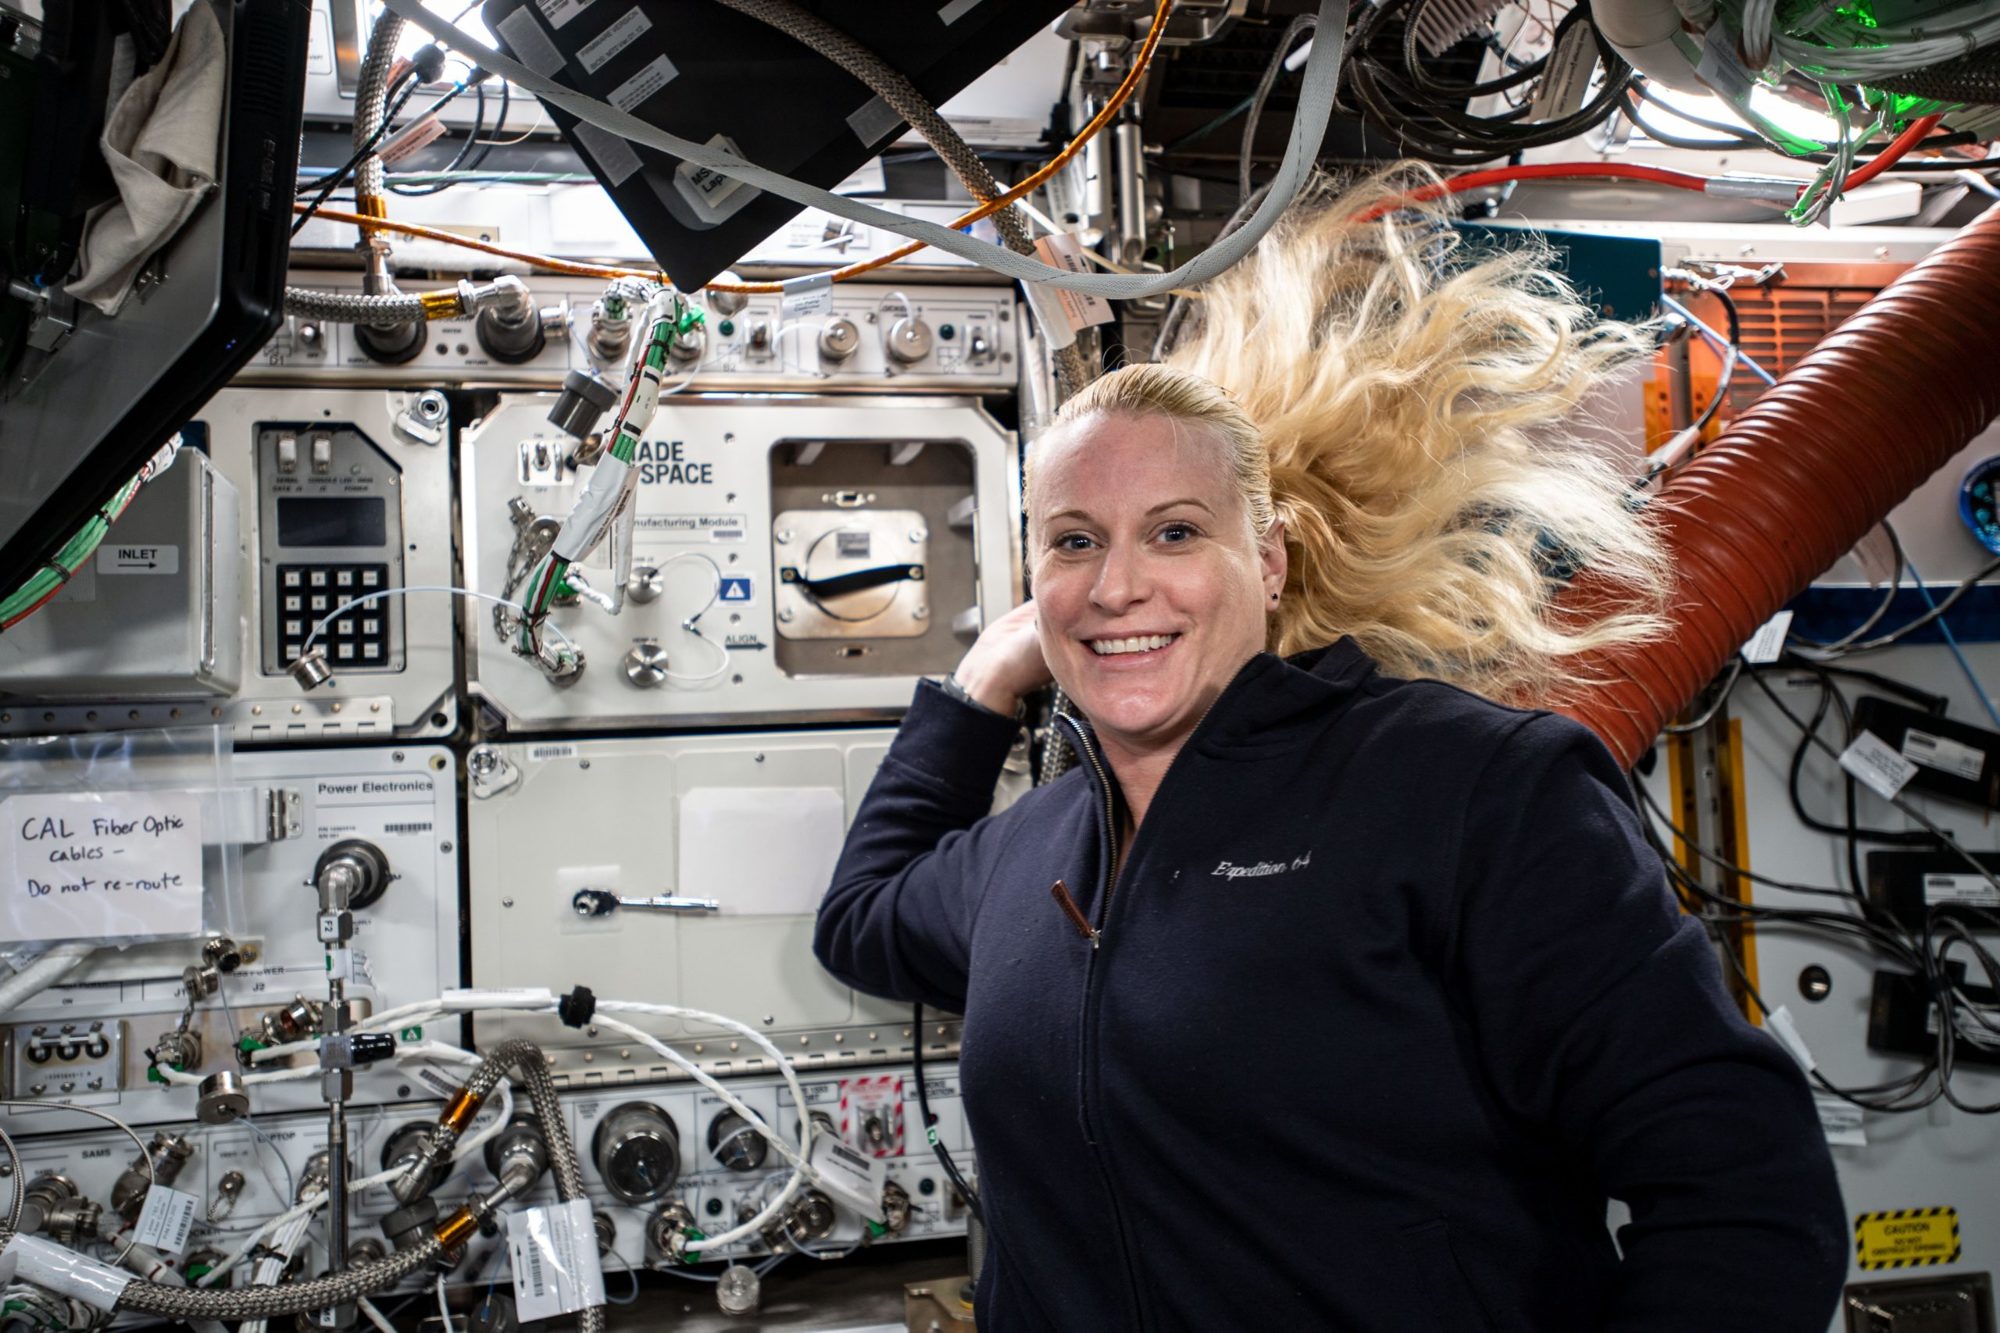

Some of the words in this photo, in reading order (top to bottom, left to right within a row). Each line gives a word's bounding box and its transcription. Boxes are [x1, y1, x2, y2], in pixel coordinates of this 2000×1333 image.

[612, 9, 639, 33] VERSION
[631, 441, 685, 462] ADE
[640, 463, 713, 485] SPACE
[633, 518, 696, 529] nufacturing
[699, 517, 738, 527] Module
[118, 548, 158, 560] INLET
[725, 634, 757, 644] ALIGN
[318, 783, 359, 795] Power
[362, 781, 434, 793] Electronics
[21, 817, 75, 842] CAL
[92, 817, 139, 838] Fiber
[143, 814, 185, 838] Optic
[49, 845, 104, 864] cables
[1210, 859, 1288, 883] Expedition
[28, 879, 52, 898] Do
[60, 876, 97, 894] not
[104, 871, 183, 892] re-route
[325, 919, 333, 932] F2
[252, 983, 266, 992] J2
[82, 1148, 112, 1160] SAMS
[1883, 1222, 1931, 1236] CAUTION
